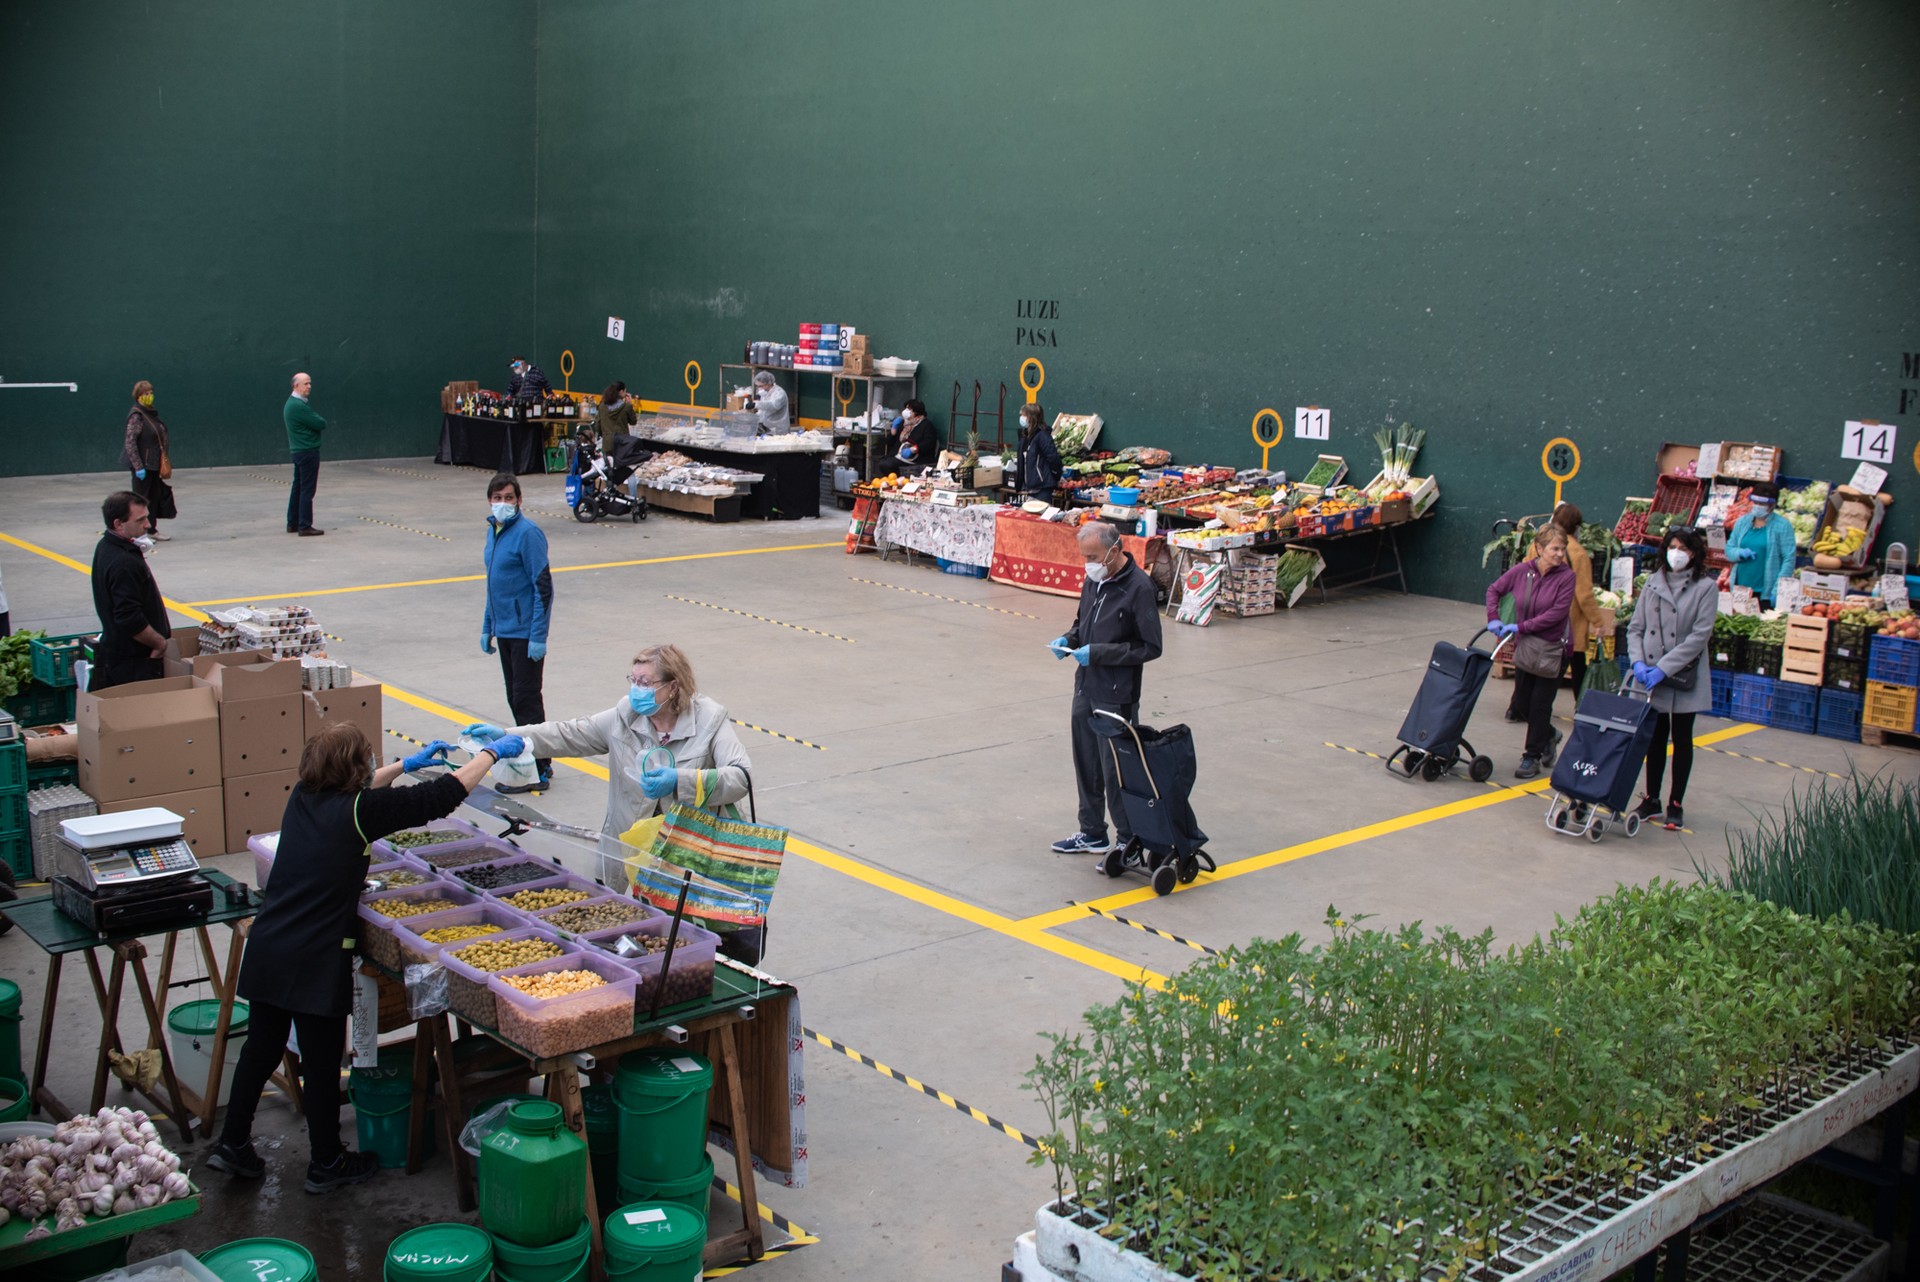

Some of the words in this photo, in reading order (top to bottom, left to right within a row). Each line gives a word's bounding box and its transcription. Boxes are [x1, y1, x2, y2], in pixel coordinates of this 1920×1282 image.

[1016, 299, 1060, 319] LUZE
[612, 320, 620, 338] 6
[840, 329, 848, 349] 8
[1016, 327, 1058, 347] PASA
[1027, 365, 1037, 385] 7
[1261, 417, 1273, 438] 6
[1301, 412, 1323, 437] 11
[1852, 427, 1889, 459] 14
[1553, 447, 1568, 471] 5
[1601, 1207, 1664, 1264] CHERRI
